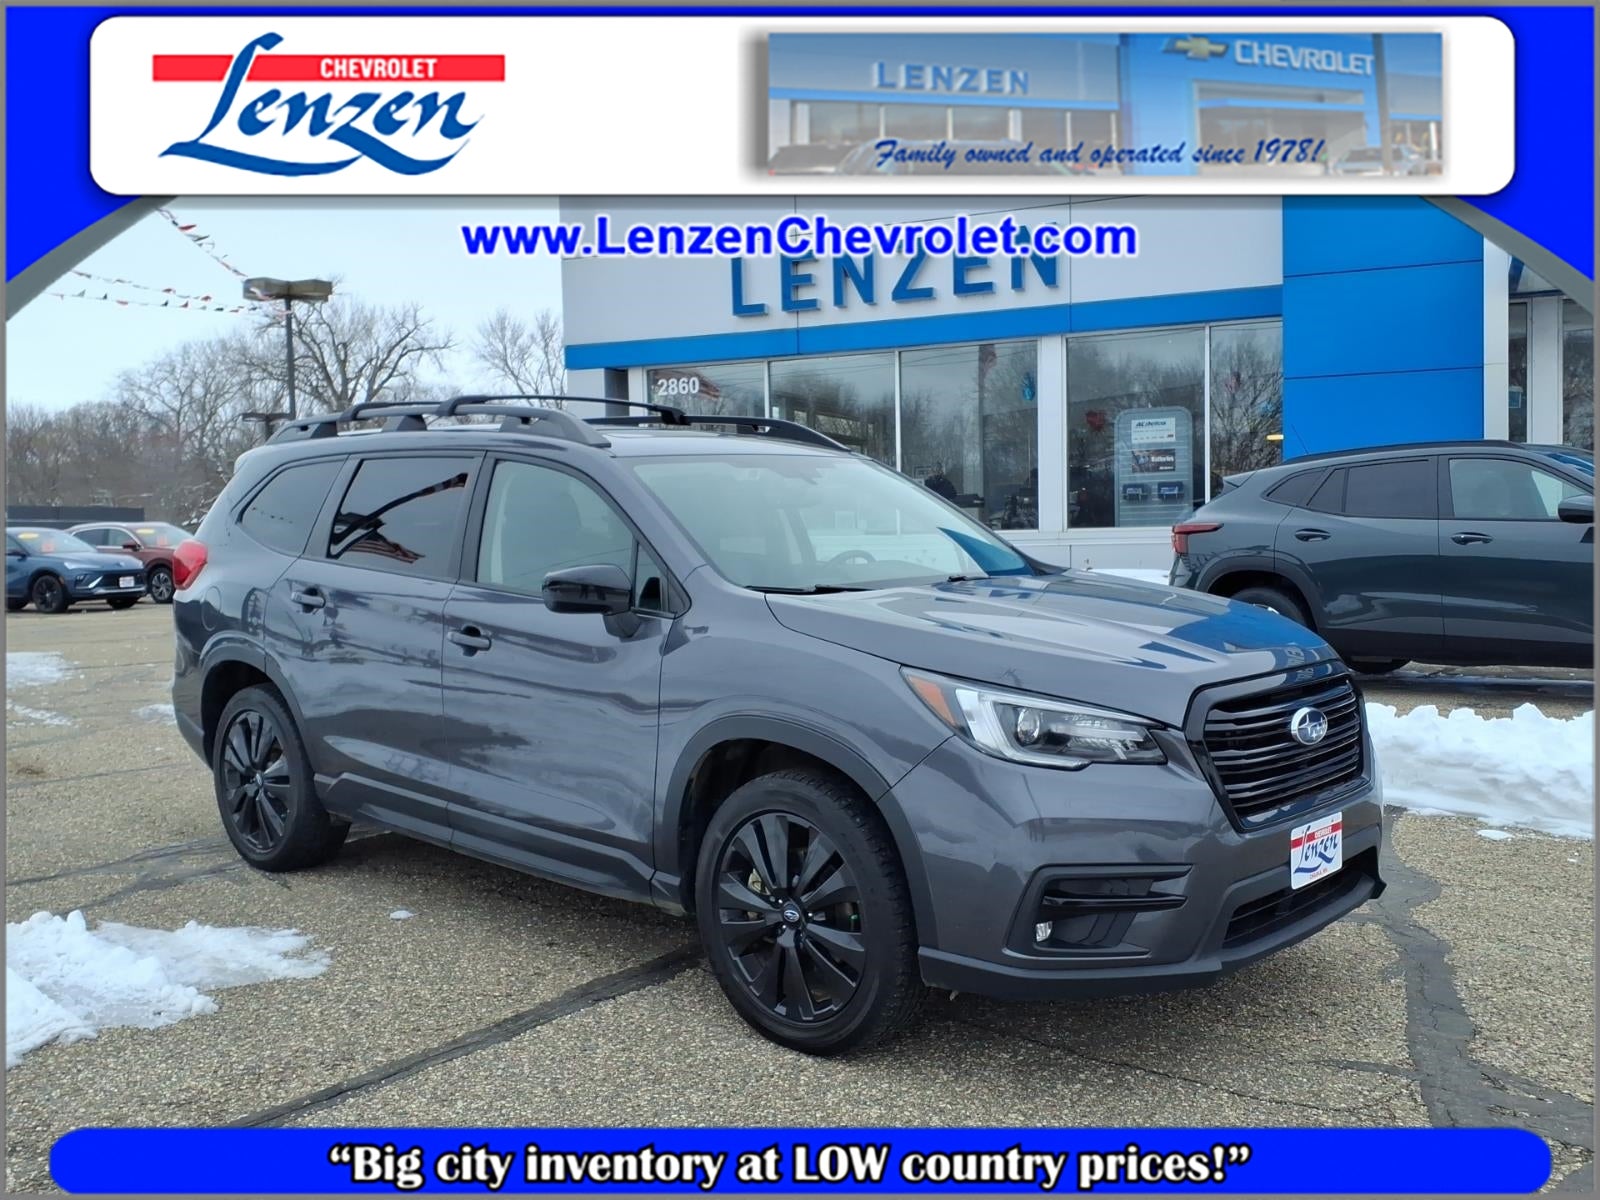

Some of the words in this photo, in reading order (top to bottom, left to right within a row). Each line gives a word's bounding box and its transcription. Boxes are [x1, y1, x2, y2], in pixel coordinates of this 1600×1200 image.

[730, 222, 1060, 318] LENZEN
[656, 376, 700, 396] 2860
[1293, 825, 1338, 875] Lenzen
